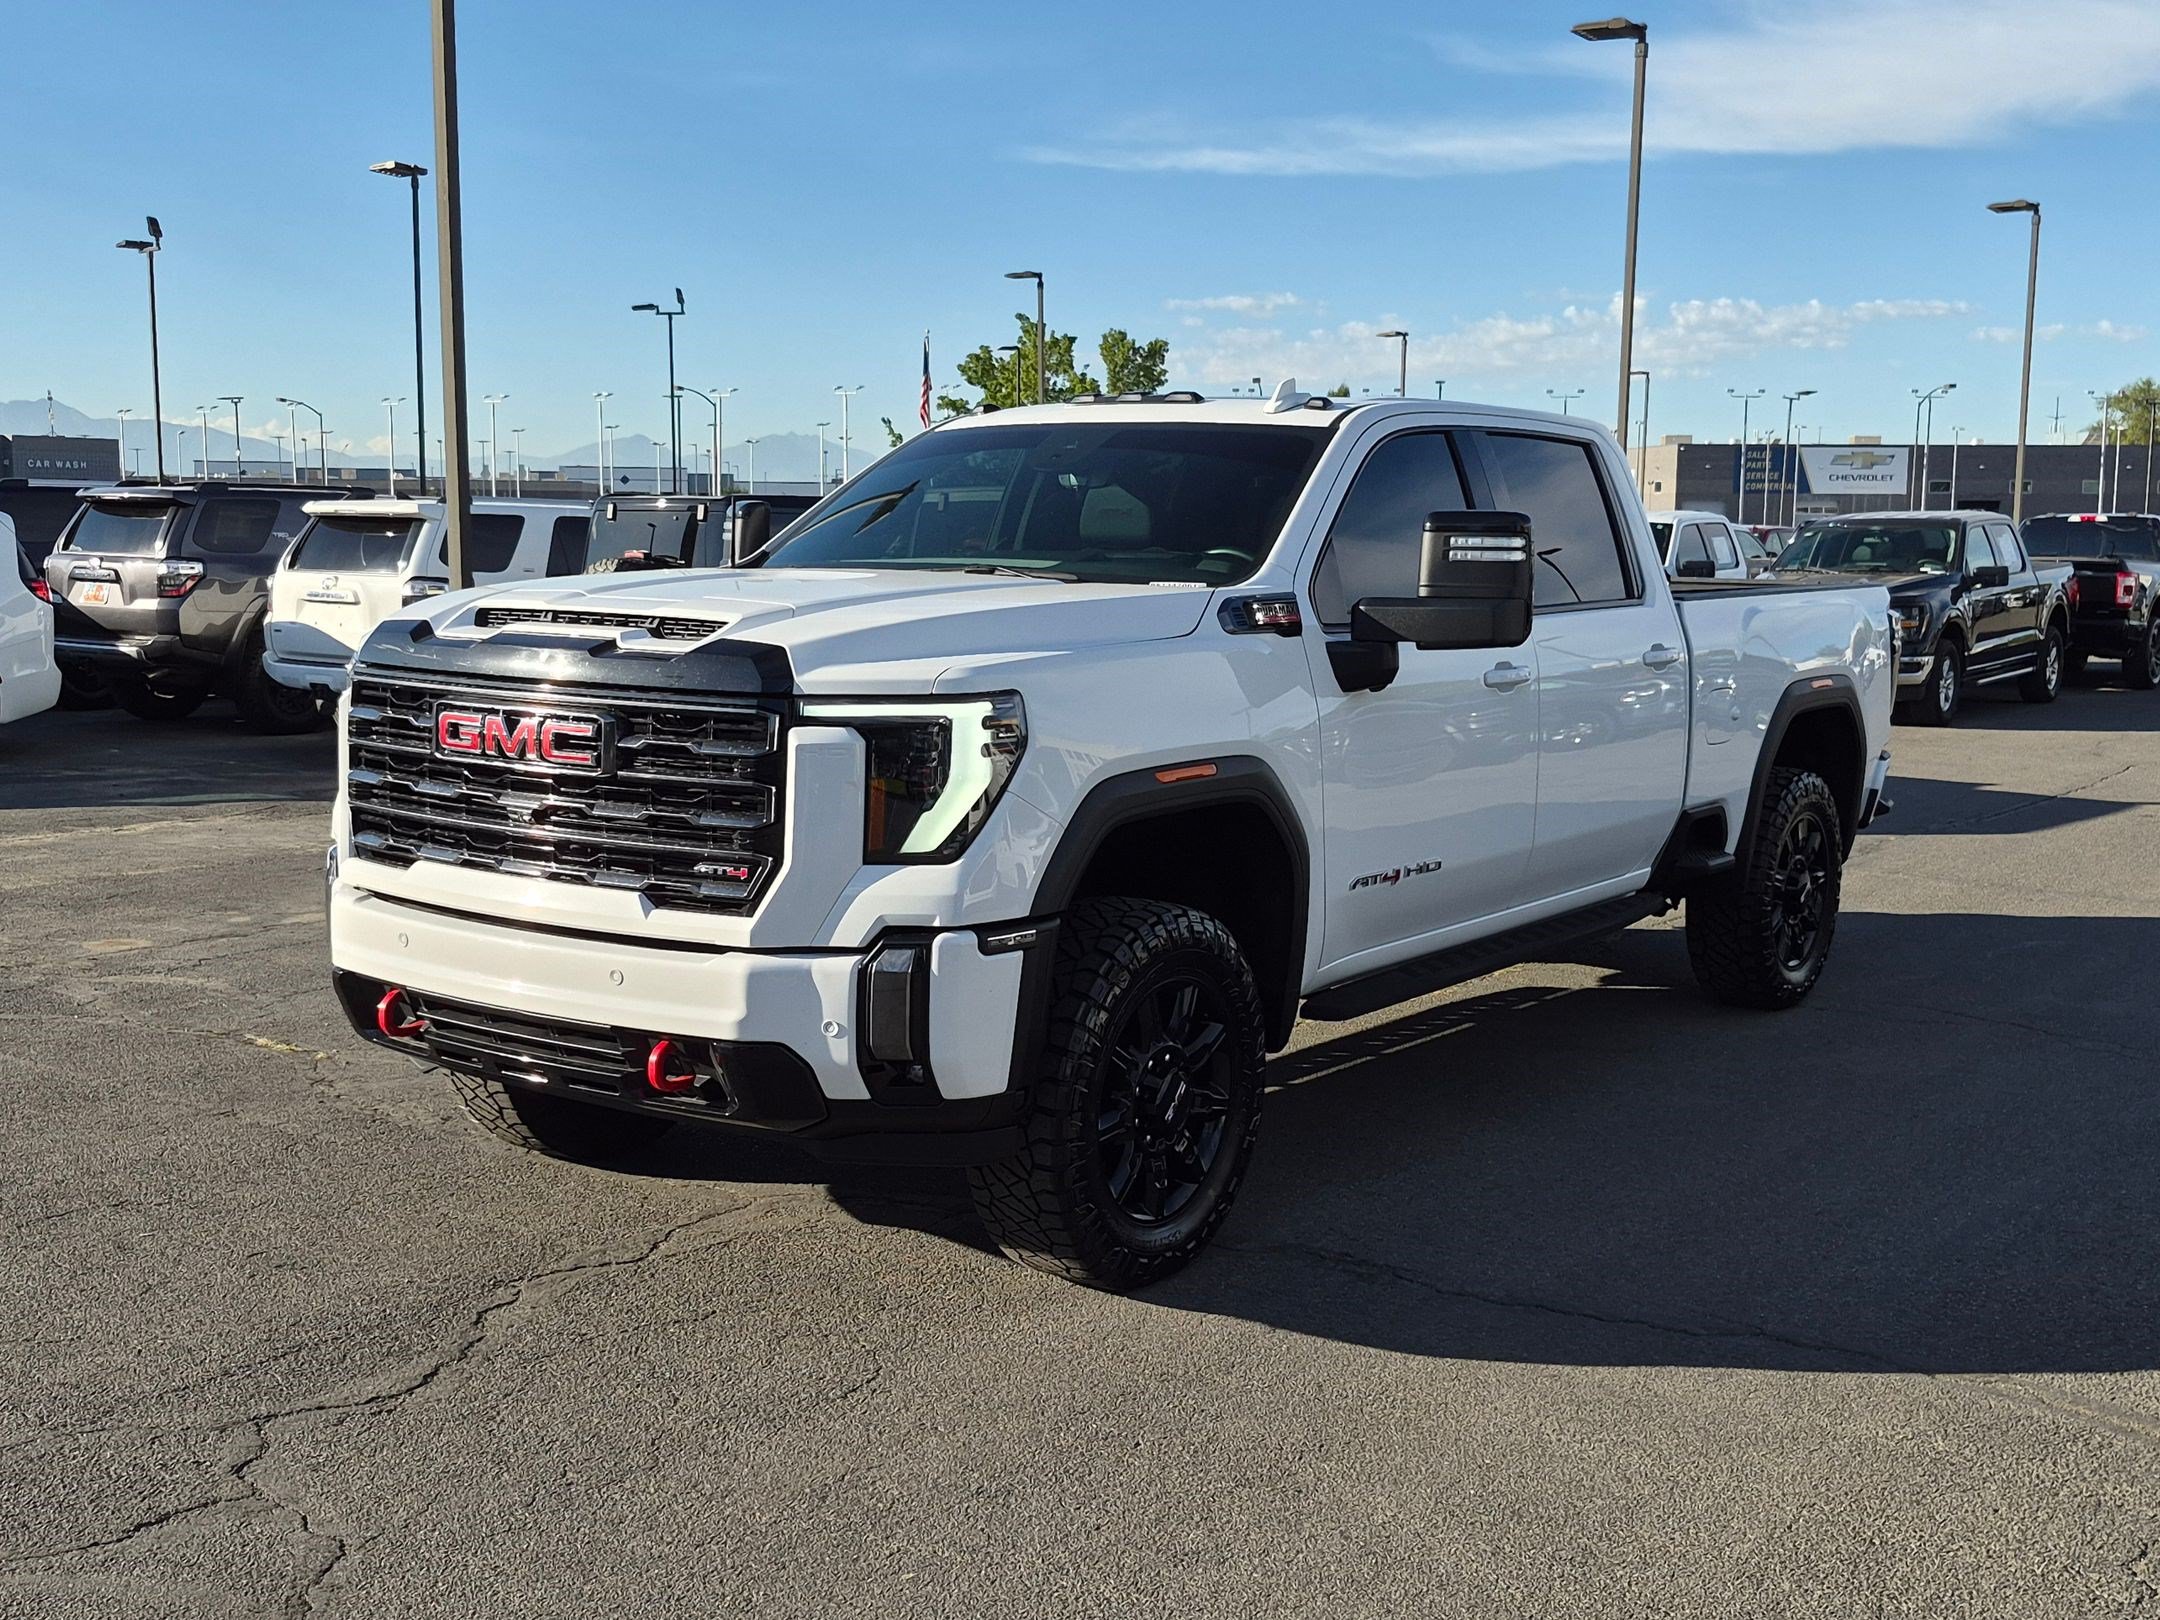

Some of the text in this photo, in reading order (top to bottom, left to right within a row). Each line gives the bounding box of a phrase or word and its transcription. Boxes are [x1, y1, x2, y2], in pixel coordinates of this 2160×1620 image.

[27, 459, 87, 469] CAR WASH
[1745, 472, 1780, 480] SERVCE
[1828, 474, 1895, 482] CHEVROLET
[1257, 603, 1296, 616] DURAMAX
[438, 710, 597, 767] GMC
[693, 862, 748, 880] AT4
[1349, 859, 1442, 891] AT4 HD
